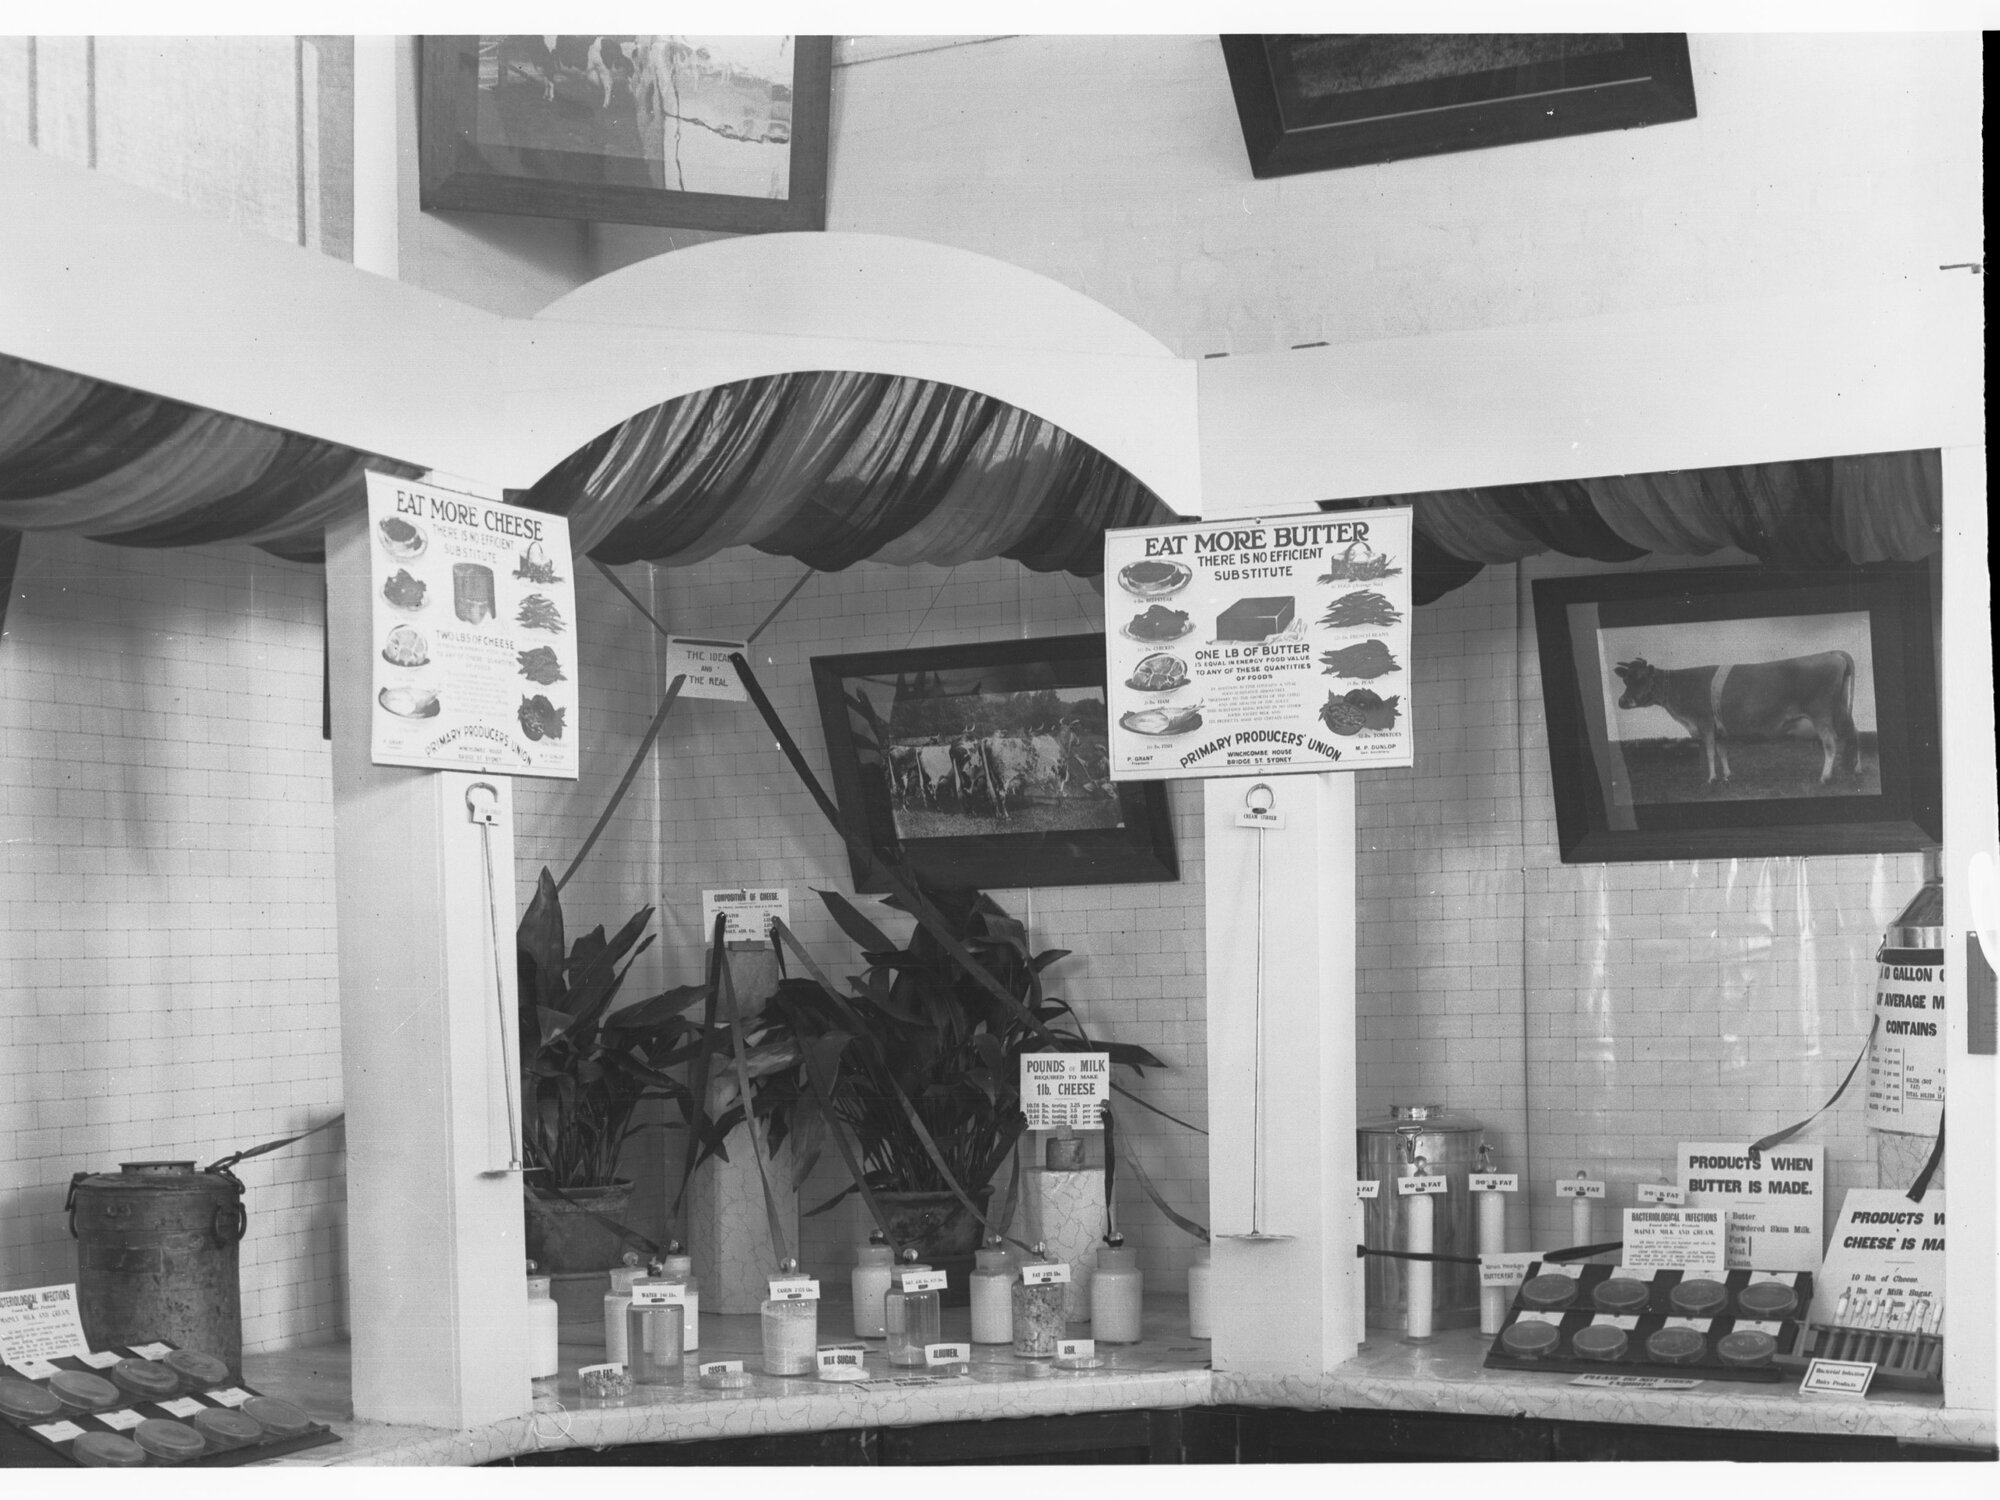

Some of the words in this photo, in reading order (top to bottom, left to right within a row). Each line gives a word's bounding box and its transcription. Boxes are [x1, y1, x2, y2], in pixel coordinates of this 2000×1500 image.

[397, 490, 425, 516] EAT
[430, 498, 479, 527] MORE
[484, 510, 543, 541] CHEESE
[433, 523, 458, 540] THERE
[462, 530, 468, 542] IS
[470, 532, 479, 543] NO
[481, 533, 515, 550] EFFICIENT
[1144, 536, 1187, 557] EAT
[1194, 529, 1267, 554] MORE
[1273, 521, 1369, 548] BUTTER
[444, 543, 497, 564] SUBSTITUTE
[1197, 554, 1236, 567] THERE
[1240, 553, 1250, 564] IS
[1252, 552, 1268, 564] NO
[1270, 547, 1323, 563] EFFICIENT
[1214, 566, 1293, 581] SUBSTITUTE
[436, 630, 454, 641] TWO
[483, 636, 515, 650] CHEESE
[686, 650, 705, 660] THE
[1195, 649, 1220, 660] ONE
[1225, 648, 1239, 659] LB
[1243, 646, 1259, 657] OF
[1262, 644, 1310, 656] BUTTER
[1264, 663, 1311, 672] QUANTITIES
[689, 675, 705, 685] THE
[708, 676, 728, 687] REAL
[425, 729, 461, 758] PRIMARY
[464, 726, 509, 747] PRODUCERS
[511, 739, 532, 765] UNION
[1179, 735, 1232, 768] PRIMARY
[1308, 738, 1342, 762] UNION
[714, 893, 746, 902] COMPOSITION
[750, 893, 756, 901] OF
[760, 892, 779, 901] CHEESE.
[1893, 967, 1933, 982] GALLON
[1884, 993, 1926, 1009] AVERAGE
[1886, 1020, 1937, 1036] CONTAINS
[1027, 1060, 1065, 1073] POUNDS
[1080, 1059, 1106, 1072] MILK
[1058, 1083, 1096, 1095] CHEESE
[1689, 1156, 1761, 1170] PRODUCTS
[1771, 1157, 1813, 1171] WHEN
[1689, 1179, 1742, 1193] BUTTER
[1749, 1180, 1762, 1193] IS
[1768, 1181, 1813, 1195] MADE.
[1631, 1212, 1680, 1222] BACTERIOLOGICAL
[1685, 1213, 1718, 1222] INFECTIONS
[1851, 1211, 1924, 1225] PRODUCTS
[1730, 1224, 1765, 1233] Powdered
[1770, 1225, 1789, 1233] Skim
[1843, 1236, 1896, 1250] CHEESE
[1901, 1238, 1916, 1250] IS
[1921, 1238, 1945, 1251] MA
[42, 1289, 70, 1302] INFECTIONS
[1887, 1288, 1903, 1296] Milk
[1909, 1289, 1933, 1297] Sugar.
[823, 1355, 836, 1365] MILK
